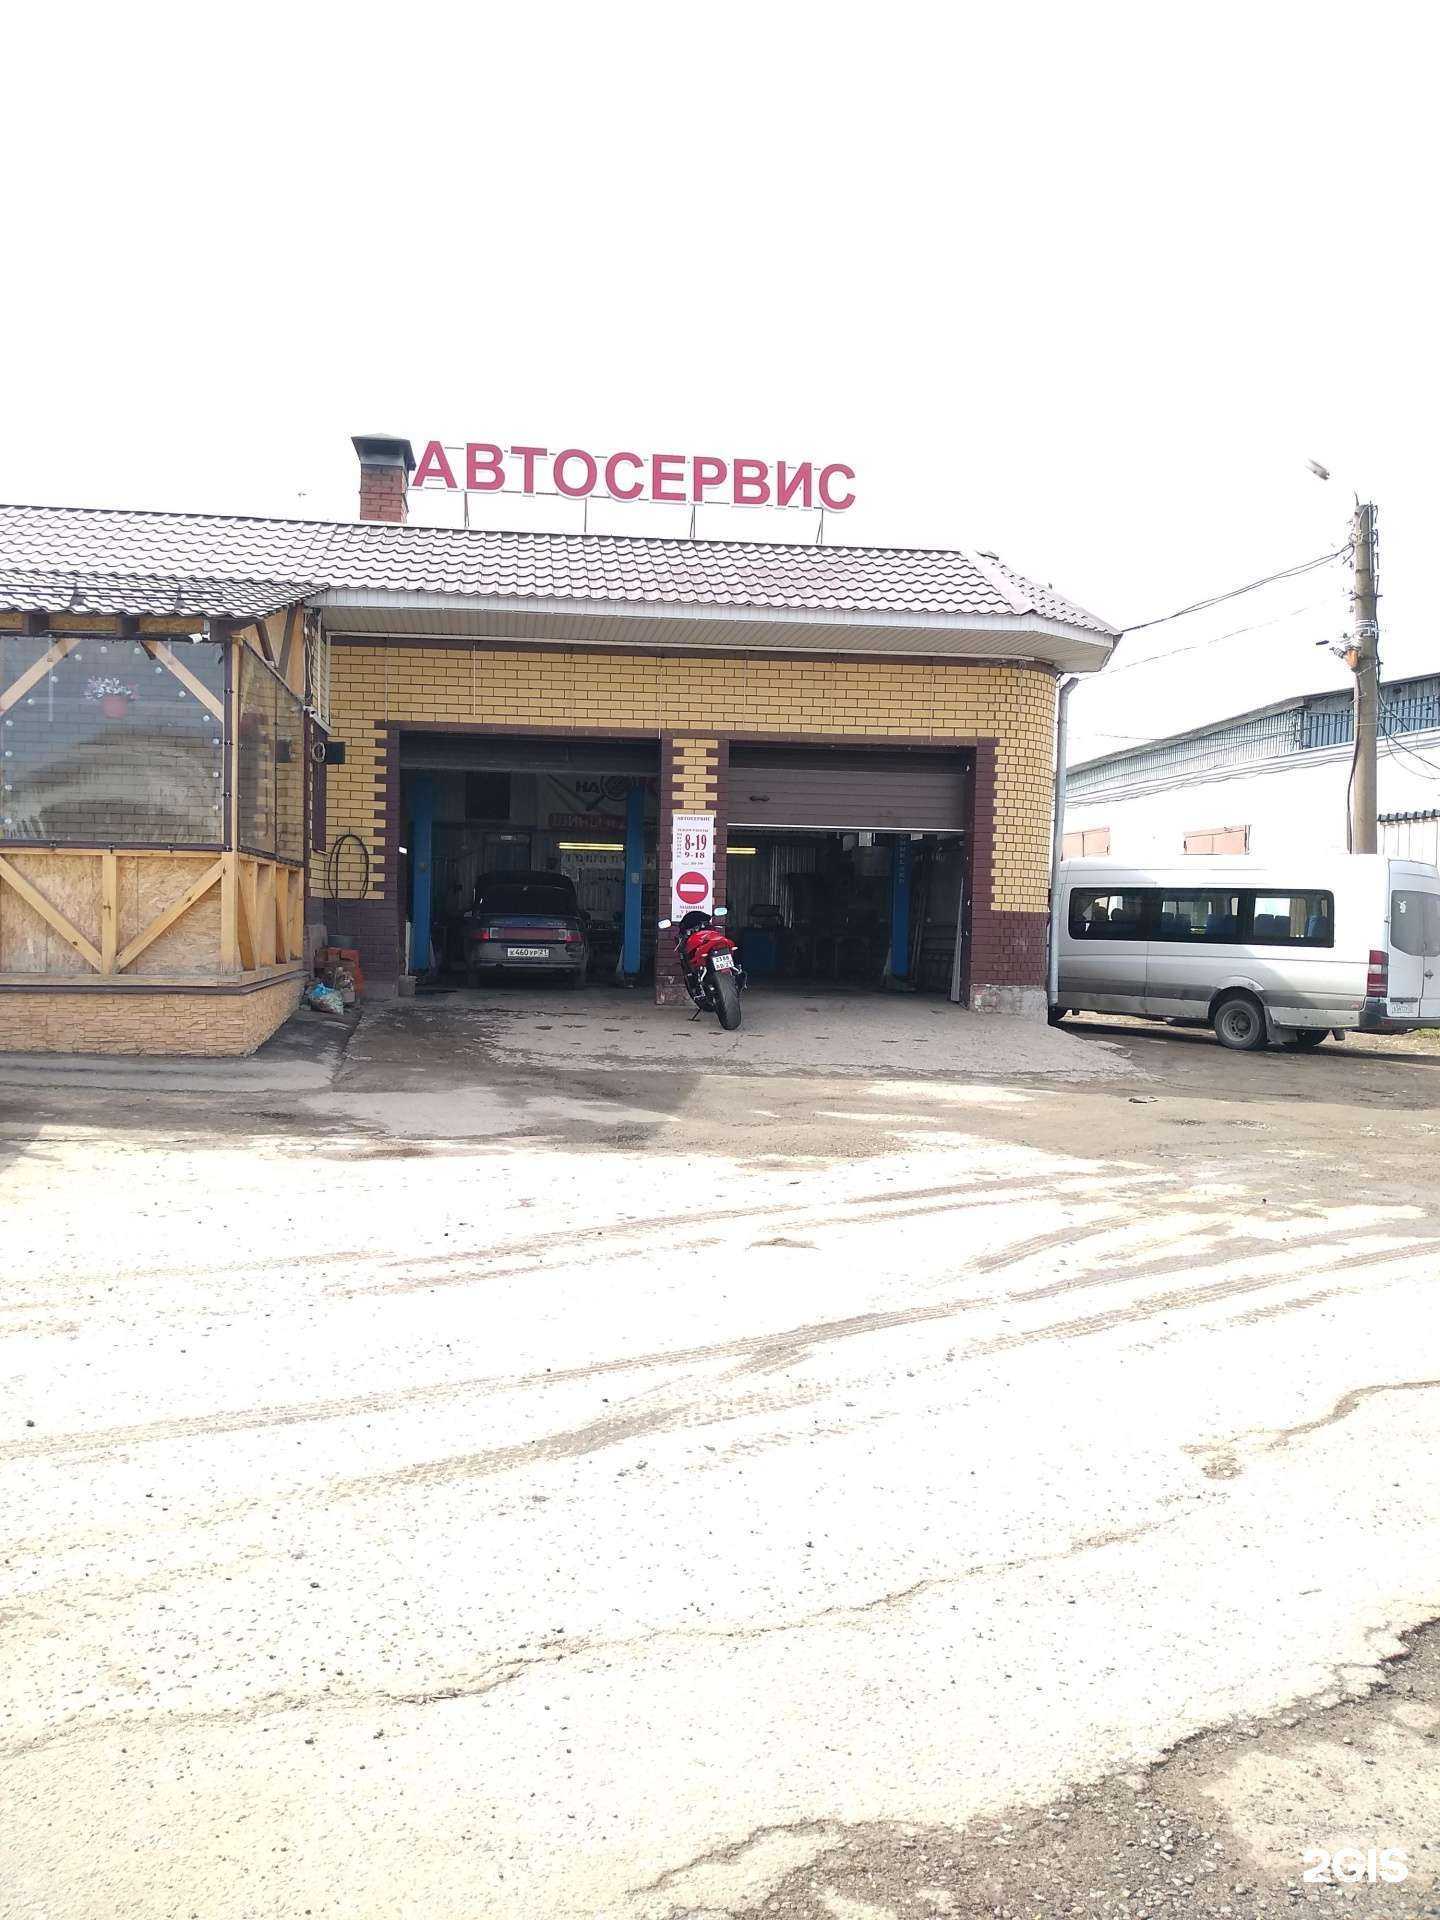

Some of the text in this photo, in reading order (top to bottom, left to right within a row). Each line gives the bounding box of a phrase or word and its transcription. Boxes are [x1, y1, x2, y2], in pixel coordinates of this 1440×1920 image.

[411, 439, 857, 513] АВТОСЕРВИС
[684, 833, 707, 851] 8-19
[684, 851, 705, 859] 9-18
